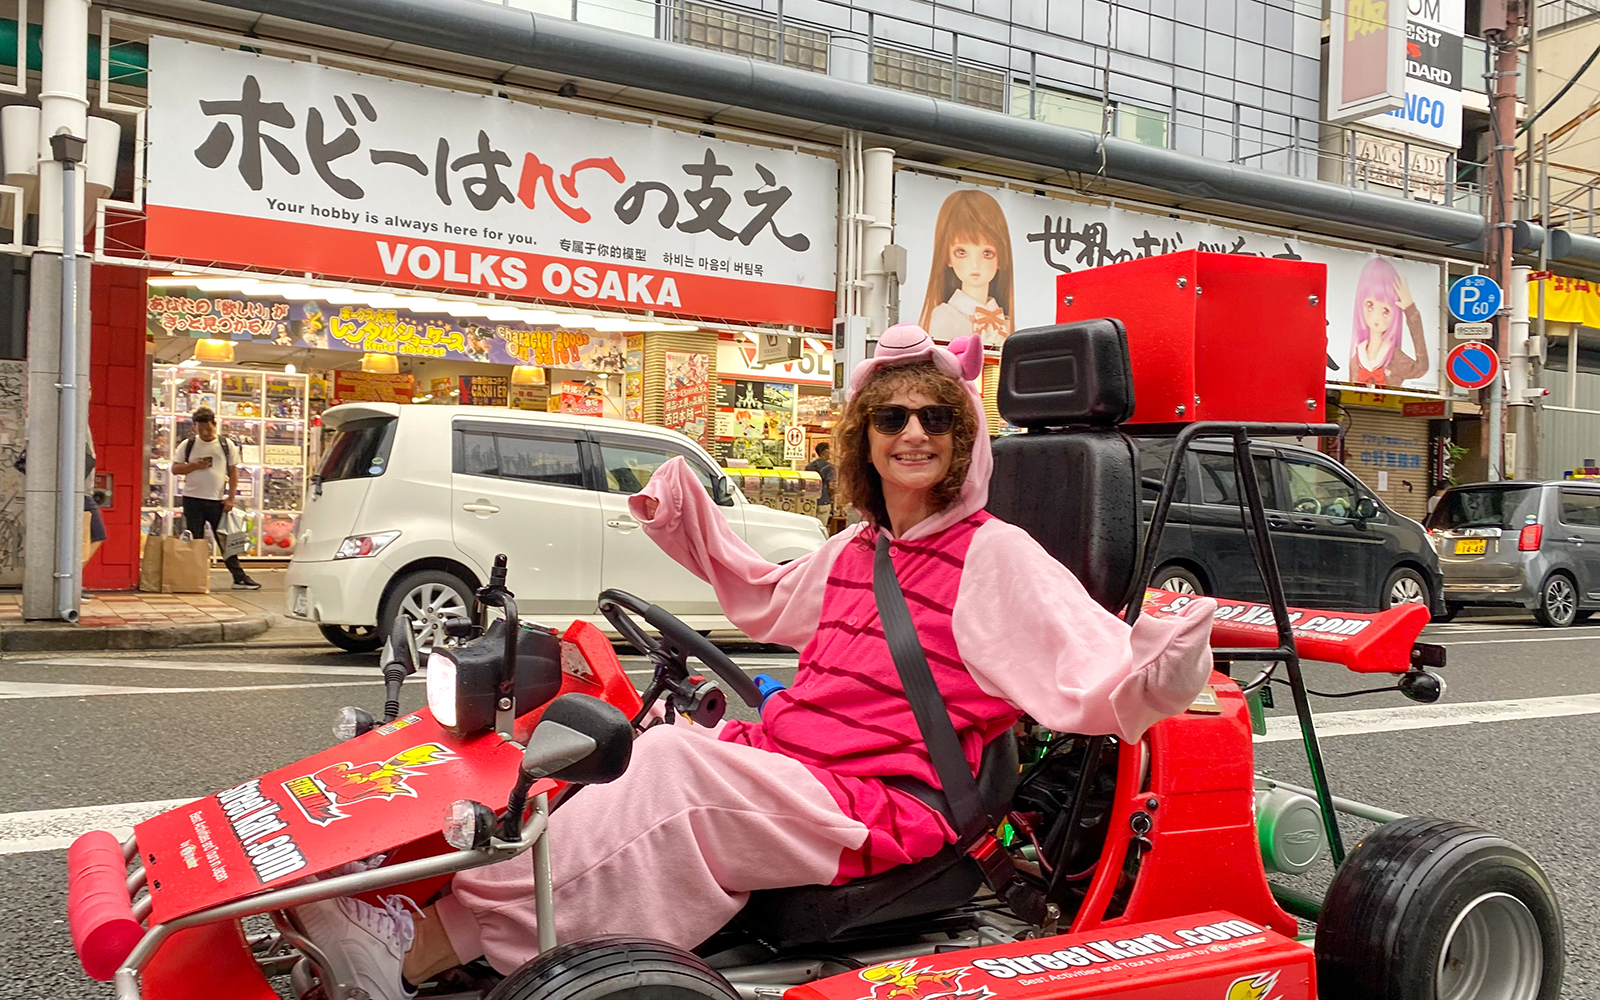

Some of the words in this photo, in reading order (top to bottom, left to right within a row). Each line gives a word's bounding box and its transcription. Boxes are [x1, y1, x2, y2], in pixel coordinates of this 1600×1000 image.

[194, 74, 810, 252] ホビーは心の支え
[267, 198, 305, 214] Your
[310, 204, 360, 224] hobby
[365, 211, 379, 224] is
[385, 216, 438, 233] always
[444, 222, 478, 237] here
[483, 227, 503, 241] for
[508, 232, 537, 245] you.
[559, 239, 647, 262] 专属于你的模型
[663, 252, 694, 268] 하비는
[698, 257, 730, 273] 마음의
[733, 262, 764, 277] 버팀목
[376, 241, 528, 290] VOLKS
[542, 262, 682, 308] OSAKA
[1459, 286, 1480, 315] P
[1472, 302, 1489, 315] 60
[330, 316, 465, 352] レンタルショーケース
[364, 340, 397, 353] Rental
[399, 345, 446, 357] showcase
[496, 324, 553, 349] Character
[556, 329, 589, 351] goods
[1233, 605, 1304, 626] Kat
[215, 779, 274, 822] Street
[230, 802, 290, 846] Kart
[970, 945, 1112, 979] Street
[1083, 932, 1184, 961] Kart
[1174, 919, 1266, 947] .com
[1018, 976, 1049, 986] Best
[1049, 968, 1101, 982] Activities
[1101, 962, 1122, 972] and
[1122, 957, 1154, 968] Tours
[1166, 950, 1197, 962] Japan
[1198, 947, 1211, 959] by
